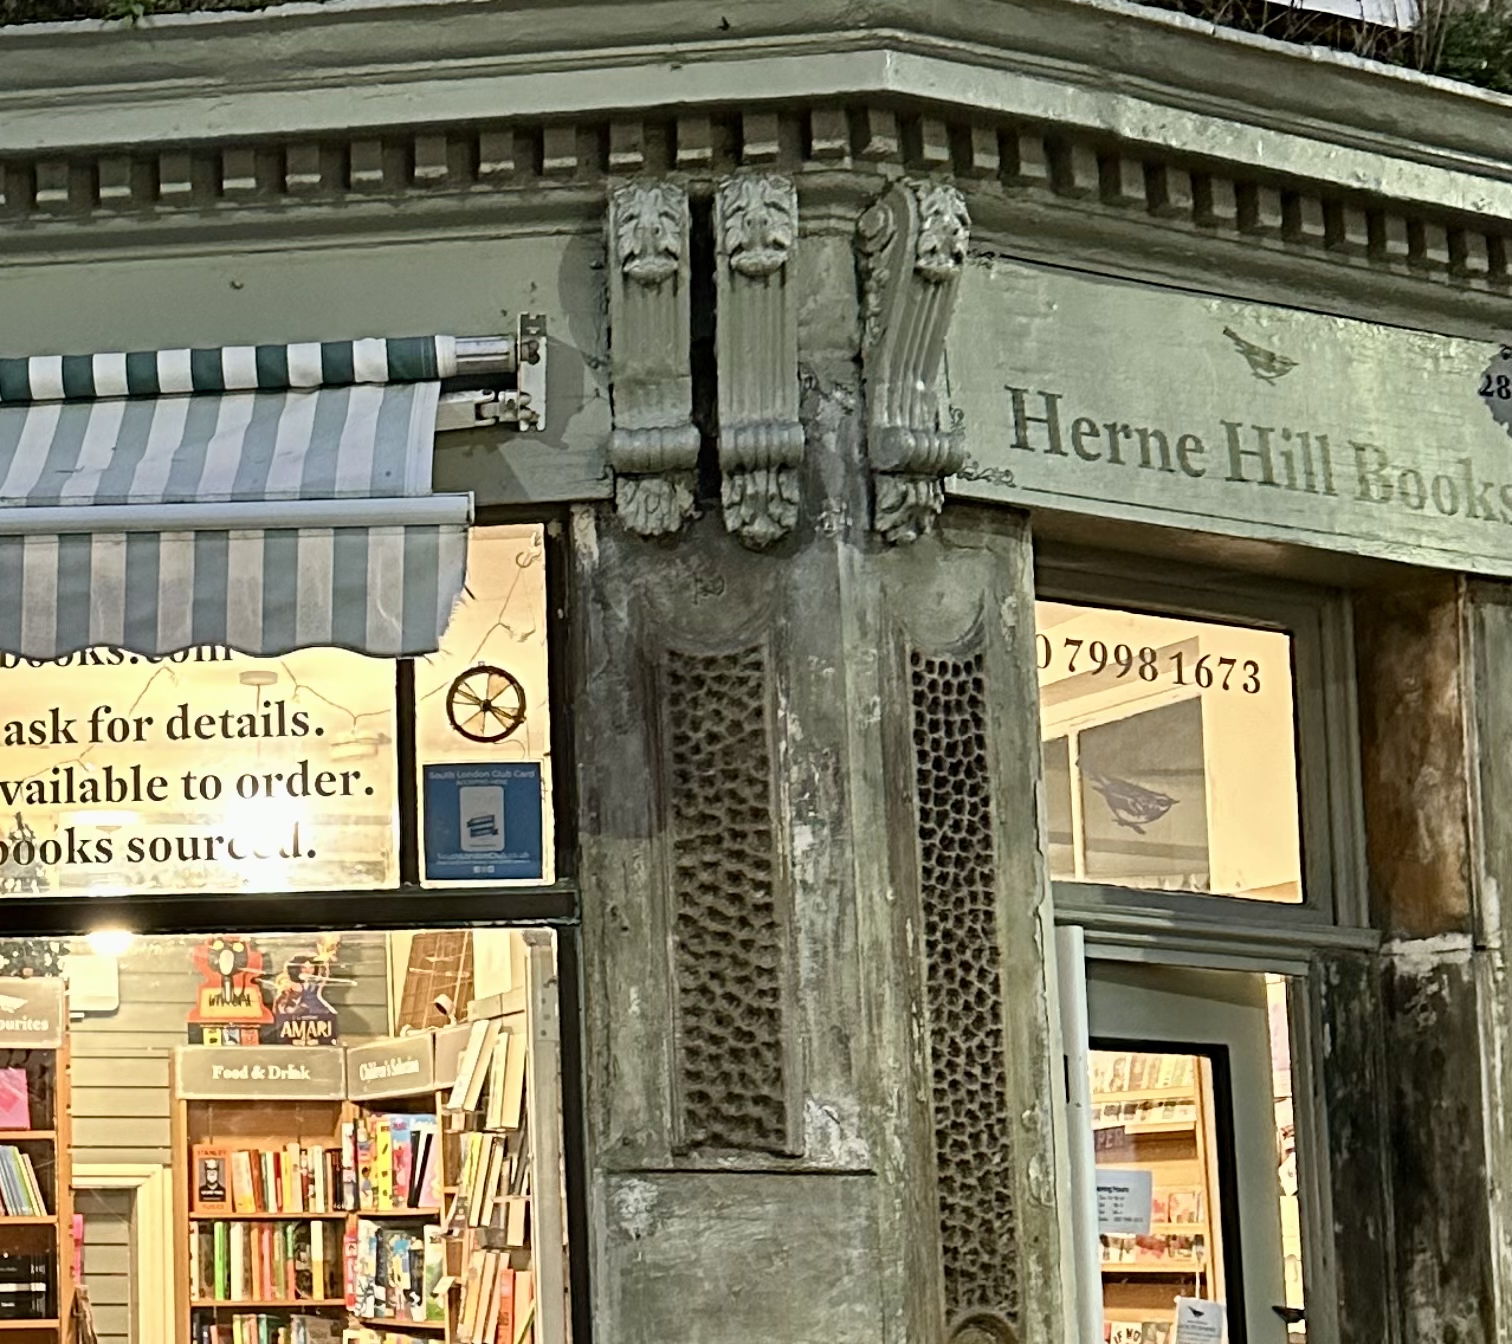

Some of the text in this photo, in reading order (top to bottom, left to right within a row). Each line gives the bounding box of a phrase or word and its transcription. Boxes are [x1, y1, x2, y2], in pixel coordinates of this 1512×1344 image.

[1004, 385, 1512, 525] Herne Hill Books
[1063, 637, 1262, 695] 7998 1673
[3, 707, 79, 745] ask
[87, 705, 155, 744] for
[166, 699, 326, 740] details.
[180, 769, 223, 802] to
[236, 759, 375, 800] order.
[457, 769, 489, 778] London
[491, 769, 512, 778] Club
[513, 769, 536, 778] Card
[126, 821, 318, 864] sourcd.
[280, 1020, 332, 1039] AMARI
[211, 1064, 312, 1081] Food & Drink
